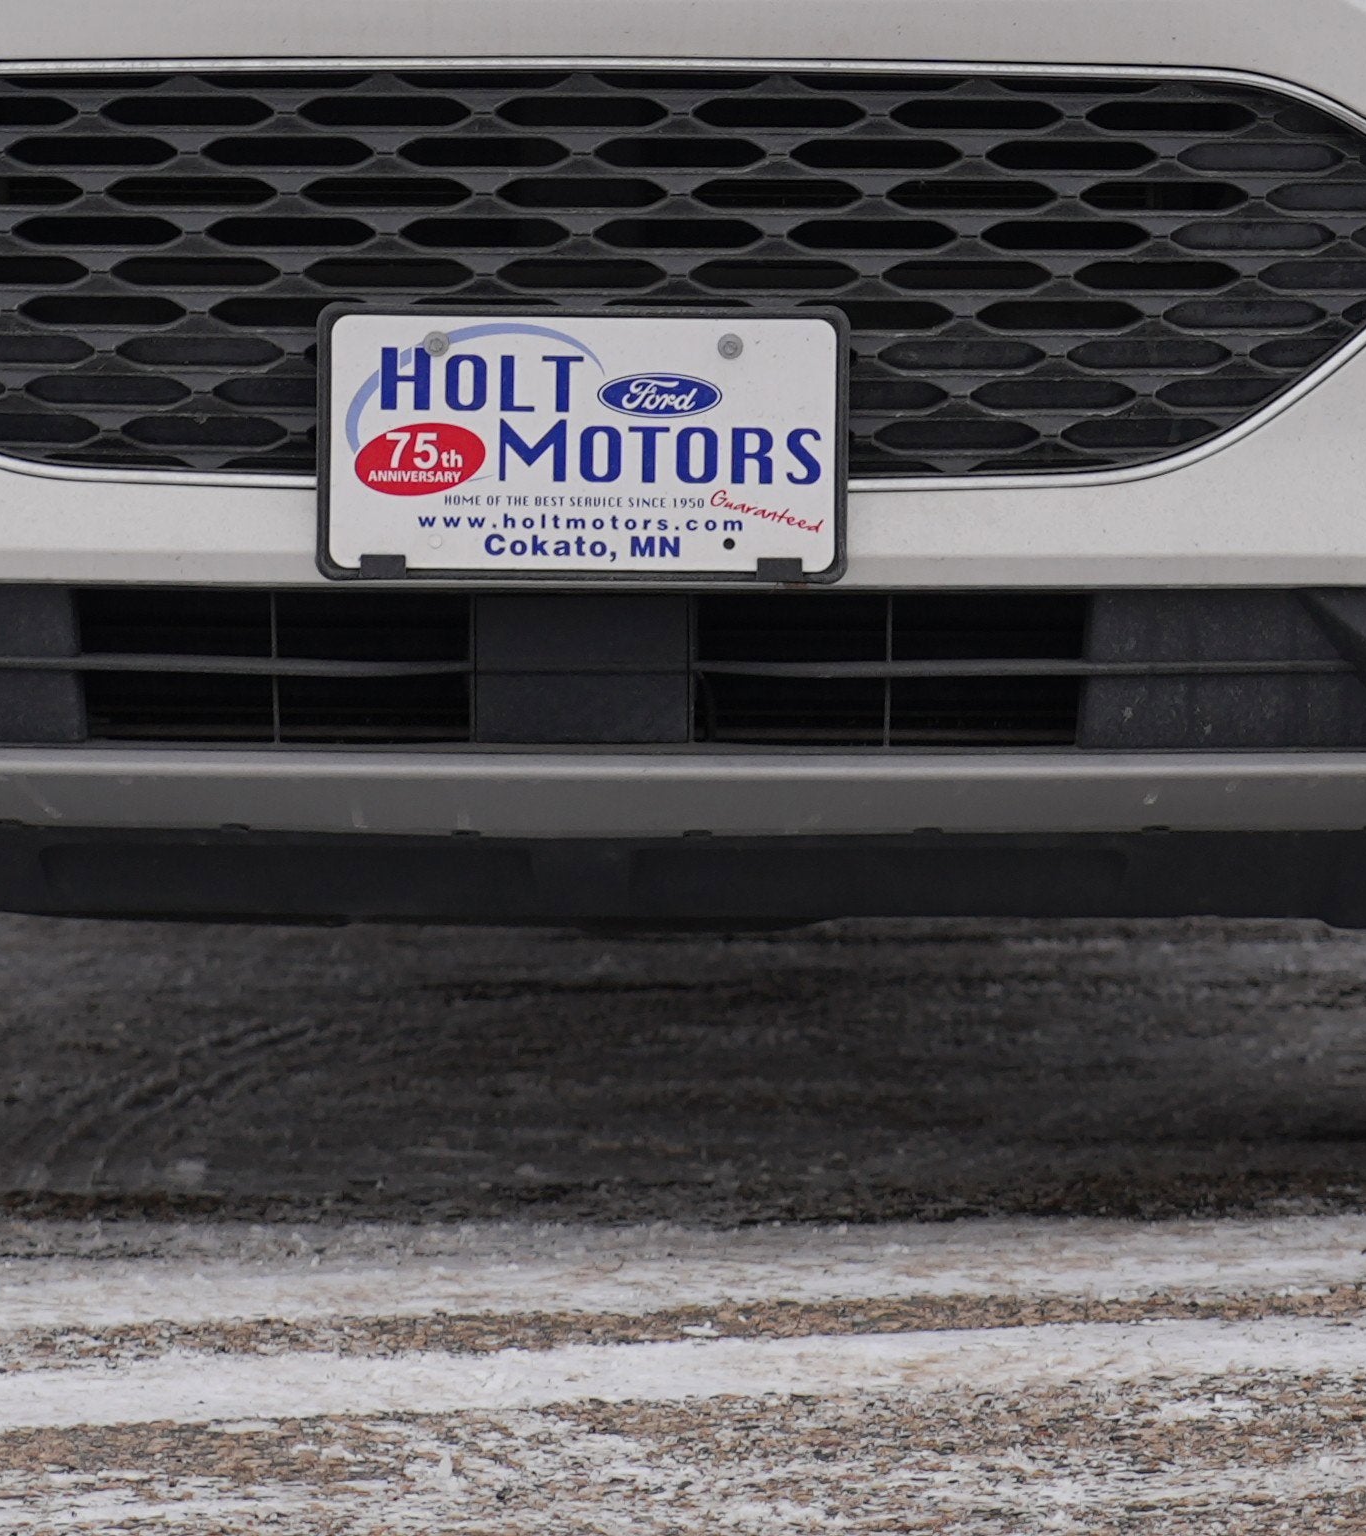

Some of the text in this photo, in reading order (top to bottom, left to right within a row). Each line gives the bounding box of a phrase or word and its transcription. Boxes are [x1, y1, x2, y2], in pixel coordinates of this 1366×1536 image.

[380, 346, 585, 413] HOLT
[622, 377, 699, 413] Ford
[385, 431, 464, 470] 75th
[498, 417, 823, 485] MOTORS
[367, 469, 463, 483] ANNIVERSARY
[444, 494, 705, 509] HOME OF THE BEST SERVICE SINCE 1950
[710, 489, 825, 533] Guaranteed
[417, 513, 744, 532] www.holtmotors.com
[484, 533, 681, 562] Cokato, MN
